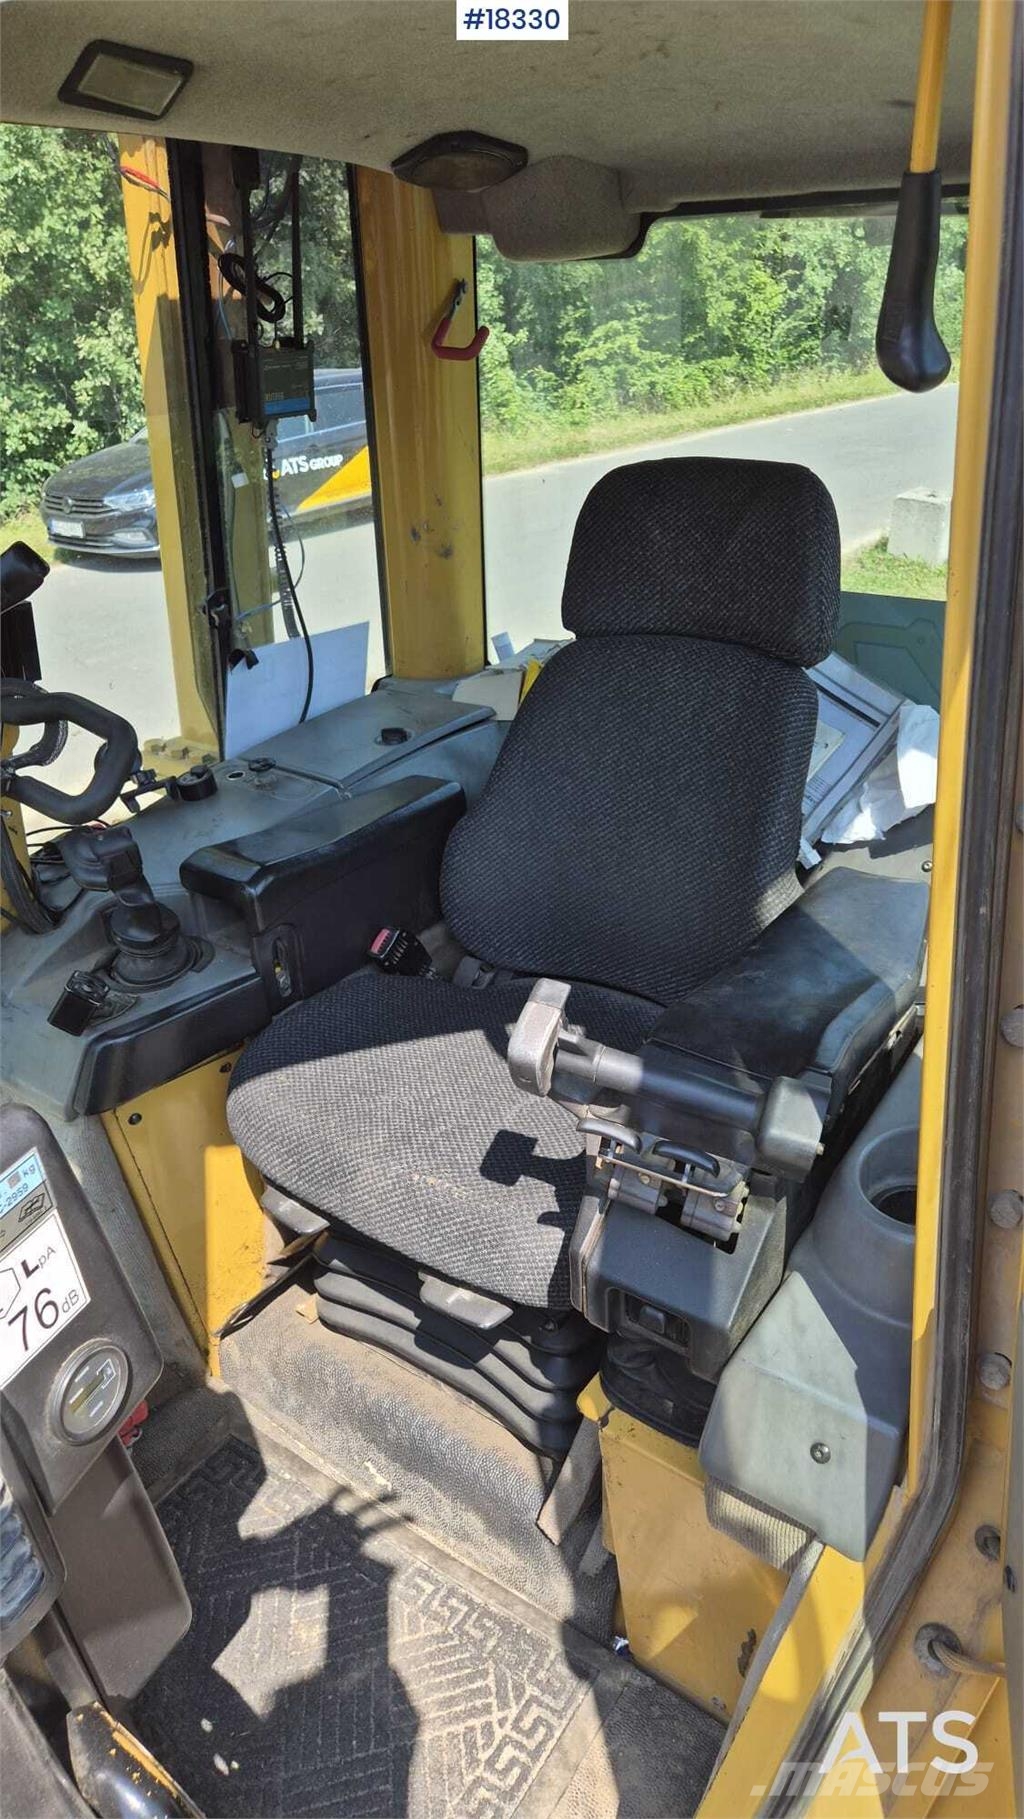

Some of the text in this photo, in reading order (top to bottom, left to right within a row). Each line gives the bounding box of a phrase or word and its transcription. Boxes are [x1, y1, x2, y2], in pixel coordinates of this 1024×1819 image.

[281, 453, 344, 476] ATS GROUP
[8, 1287, 80, 1352] 76 dB
